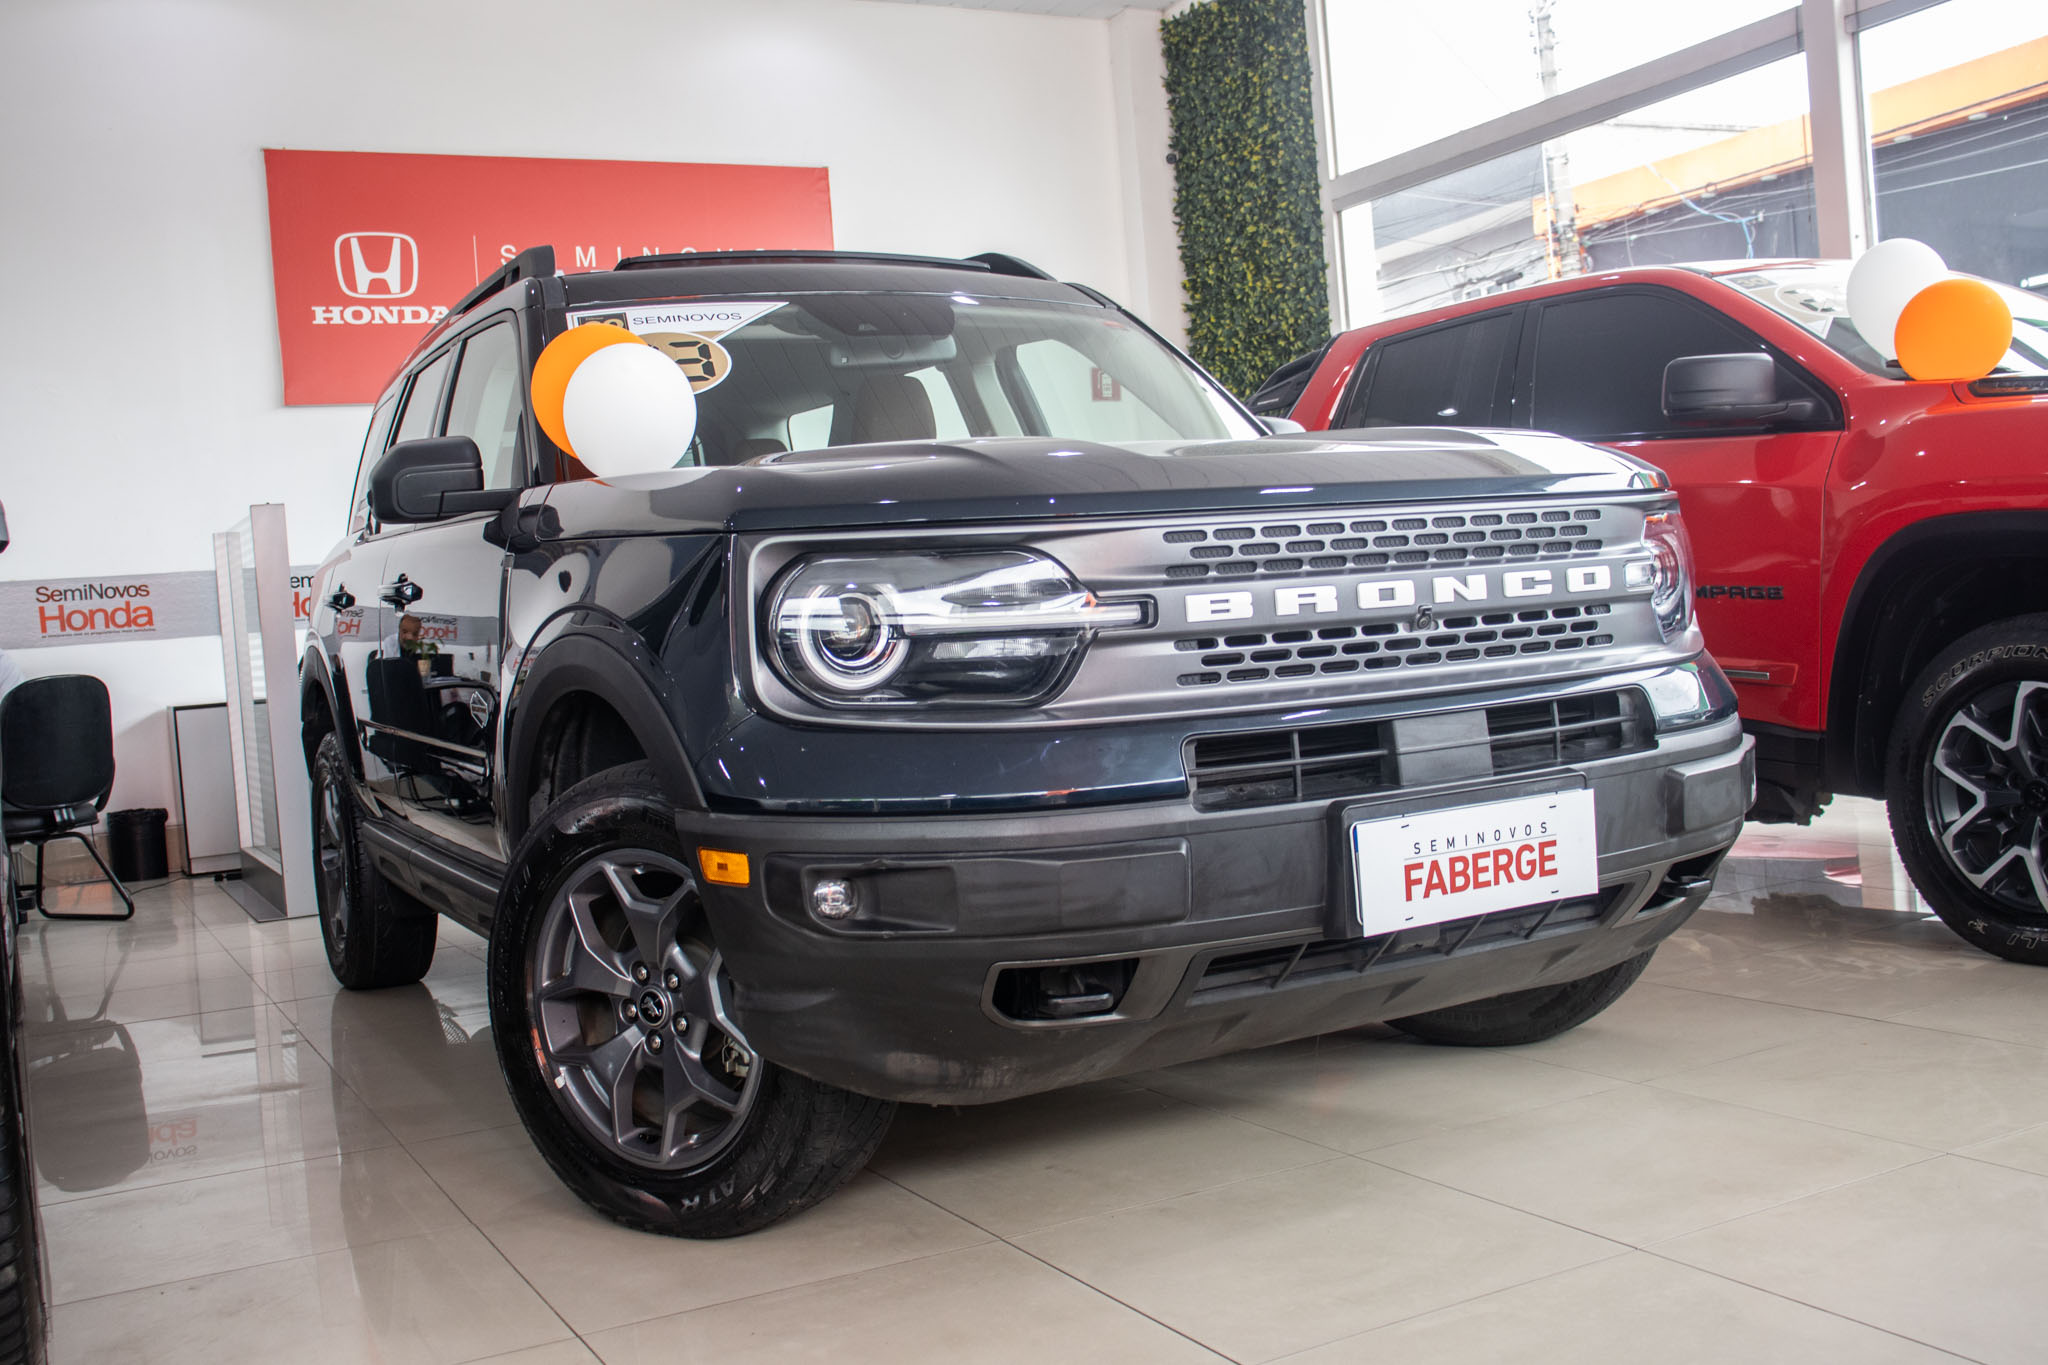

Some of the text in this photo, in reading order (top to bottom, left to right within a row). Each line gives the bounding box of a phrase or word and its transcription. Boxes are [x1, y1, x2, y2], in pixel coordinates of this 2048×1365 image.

[311, 305, 450, 325] HONDA
[632, 312, 742, 326] SEMINOVOS
[35, 583, 150, 603] SemiNovos
[1185, 564, 1611, 623] BRONCO
[1696, 585, 1784, 600] MPAGE
[38, 600, 155, 634] Honda
[1413, 821, 1548, 855] SEMINOVOS
[1404, 839, 1558, 902] FABERGE
